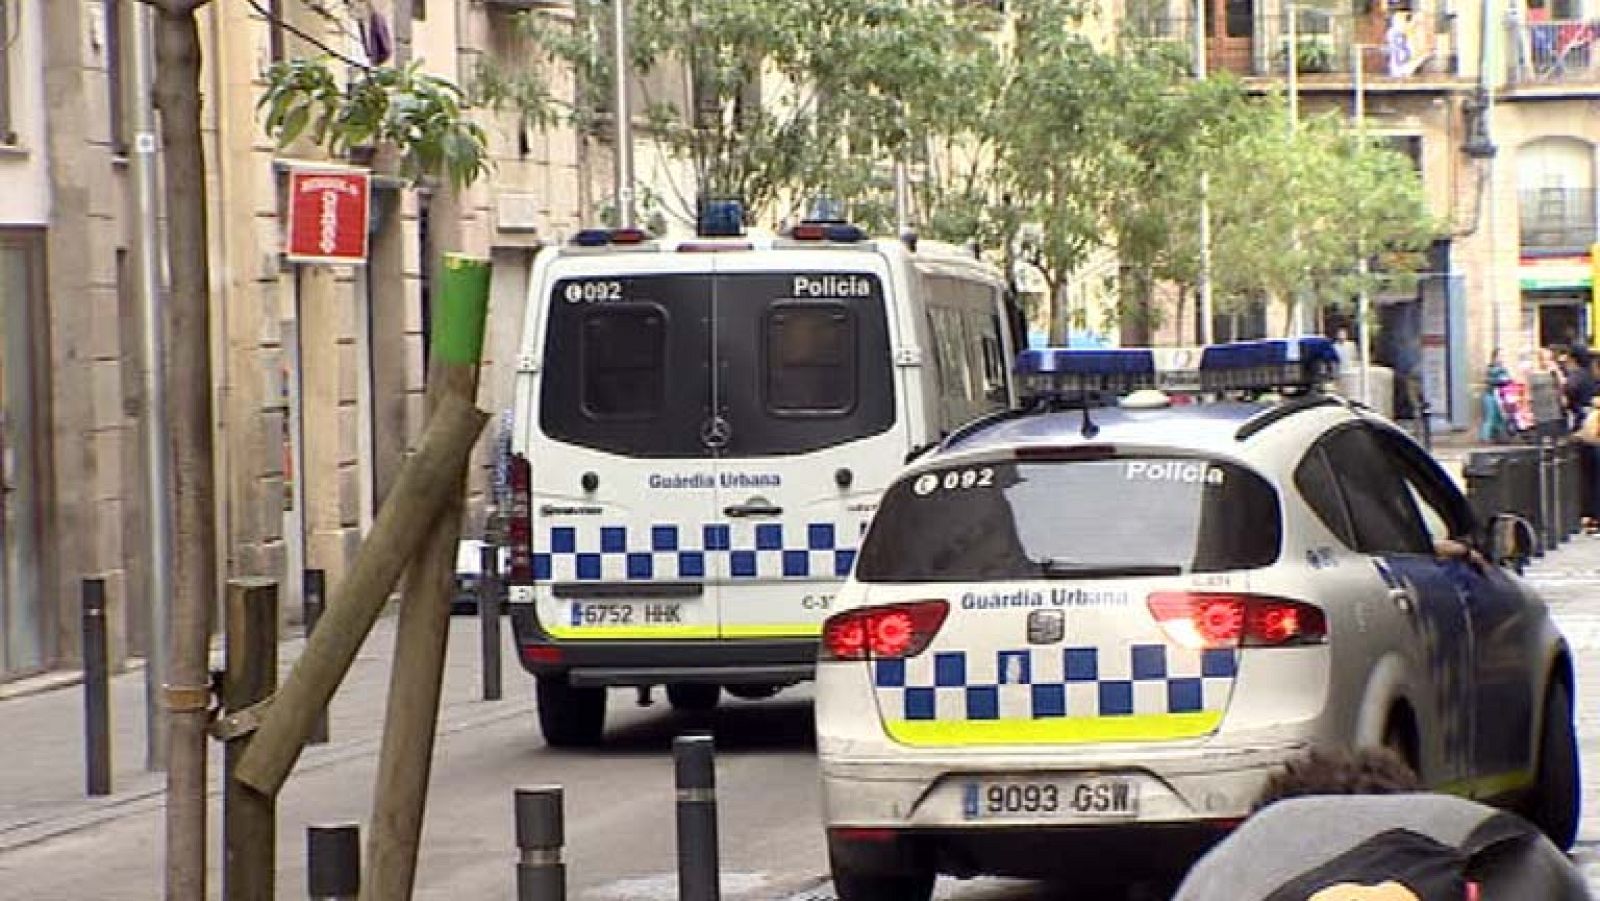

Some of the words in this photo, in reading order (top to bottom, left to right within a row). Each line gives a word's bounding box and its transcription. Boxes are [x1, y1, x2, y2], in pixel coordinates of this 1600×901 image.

[584, 281, 622, 303] 092
[794, 275, 870, 297] Policia
[720, 471, 782, 489] Urbana
[943, 468, 995, 489] 092
[1126, 462, 1224, 484] Policia
[1050, 587, 1129, 607] Urbana
[585, 604, 633, 624] 6752
[987, 784, 1058, 812] 9093
[1074, 783, 1130, 812] GSW
